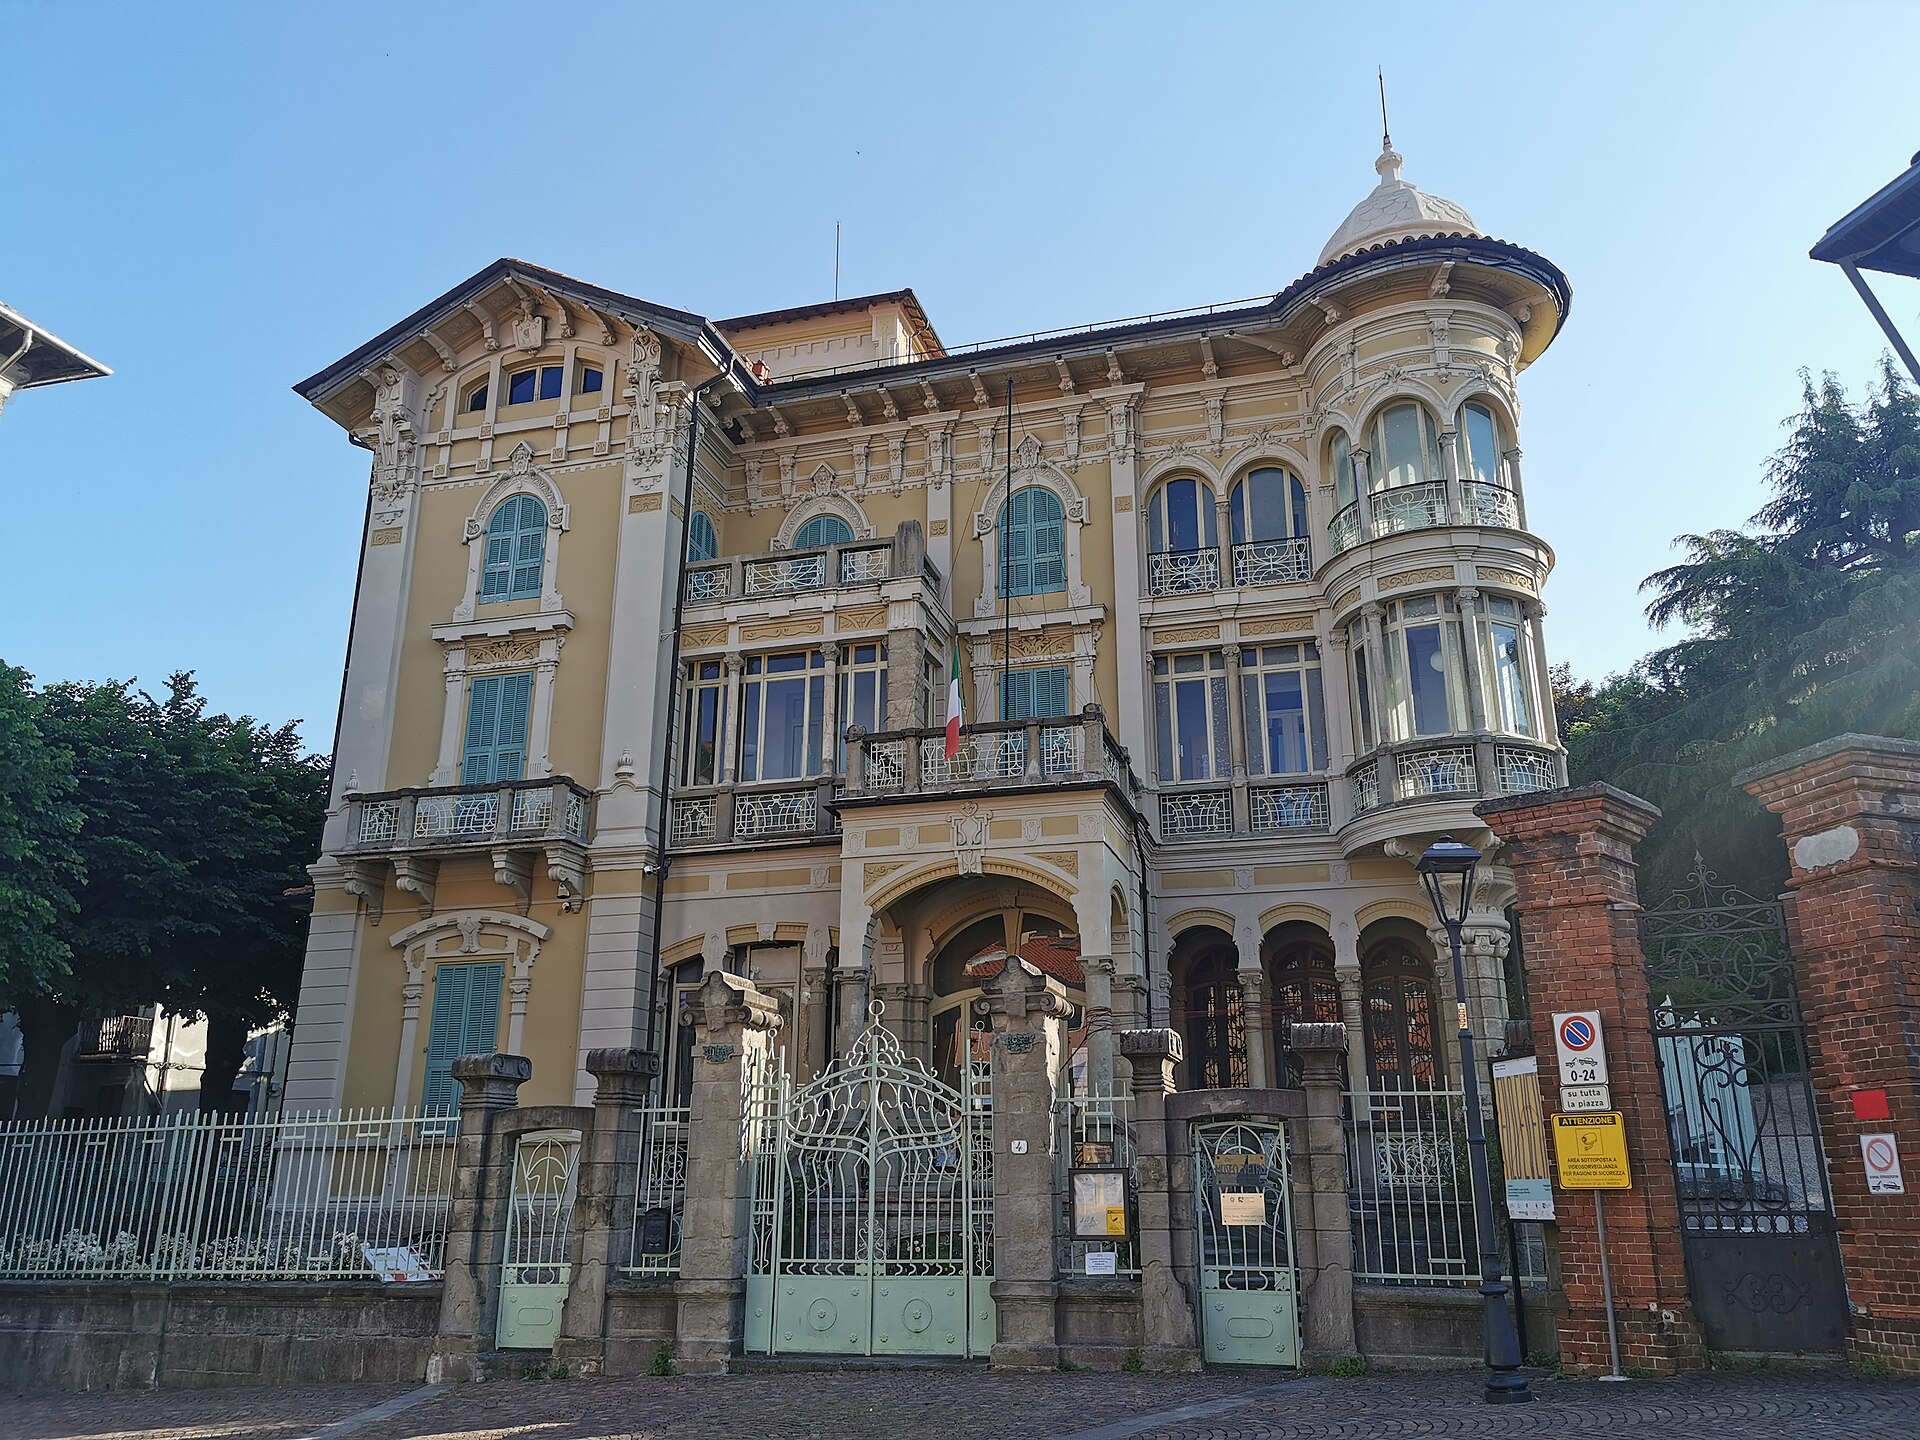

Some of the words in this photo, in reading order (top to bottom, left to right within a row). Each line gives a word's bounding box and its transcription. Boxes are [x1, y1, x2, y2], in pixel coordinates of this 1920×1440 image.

[1570, 1069, 1596, 1082] 0-24
[1579, 1089, 1601, 1097] tutta
[1578, 1100, 1604, 1108] piazza
[1561, 1117, 1613, 1126] ATTENZIONE
